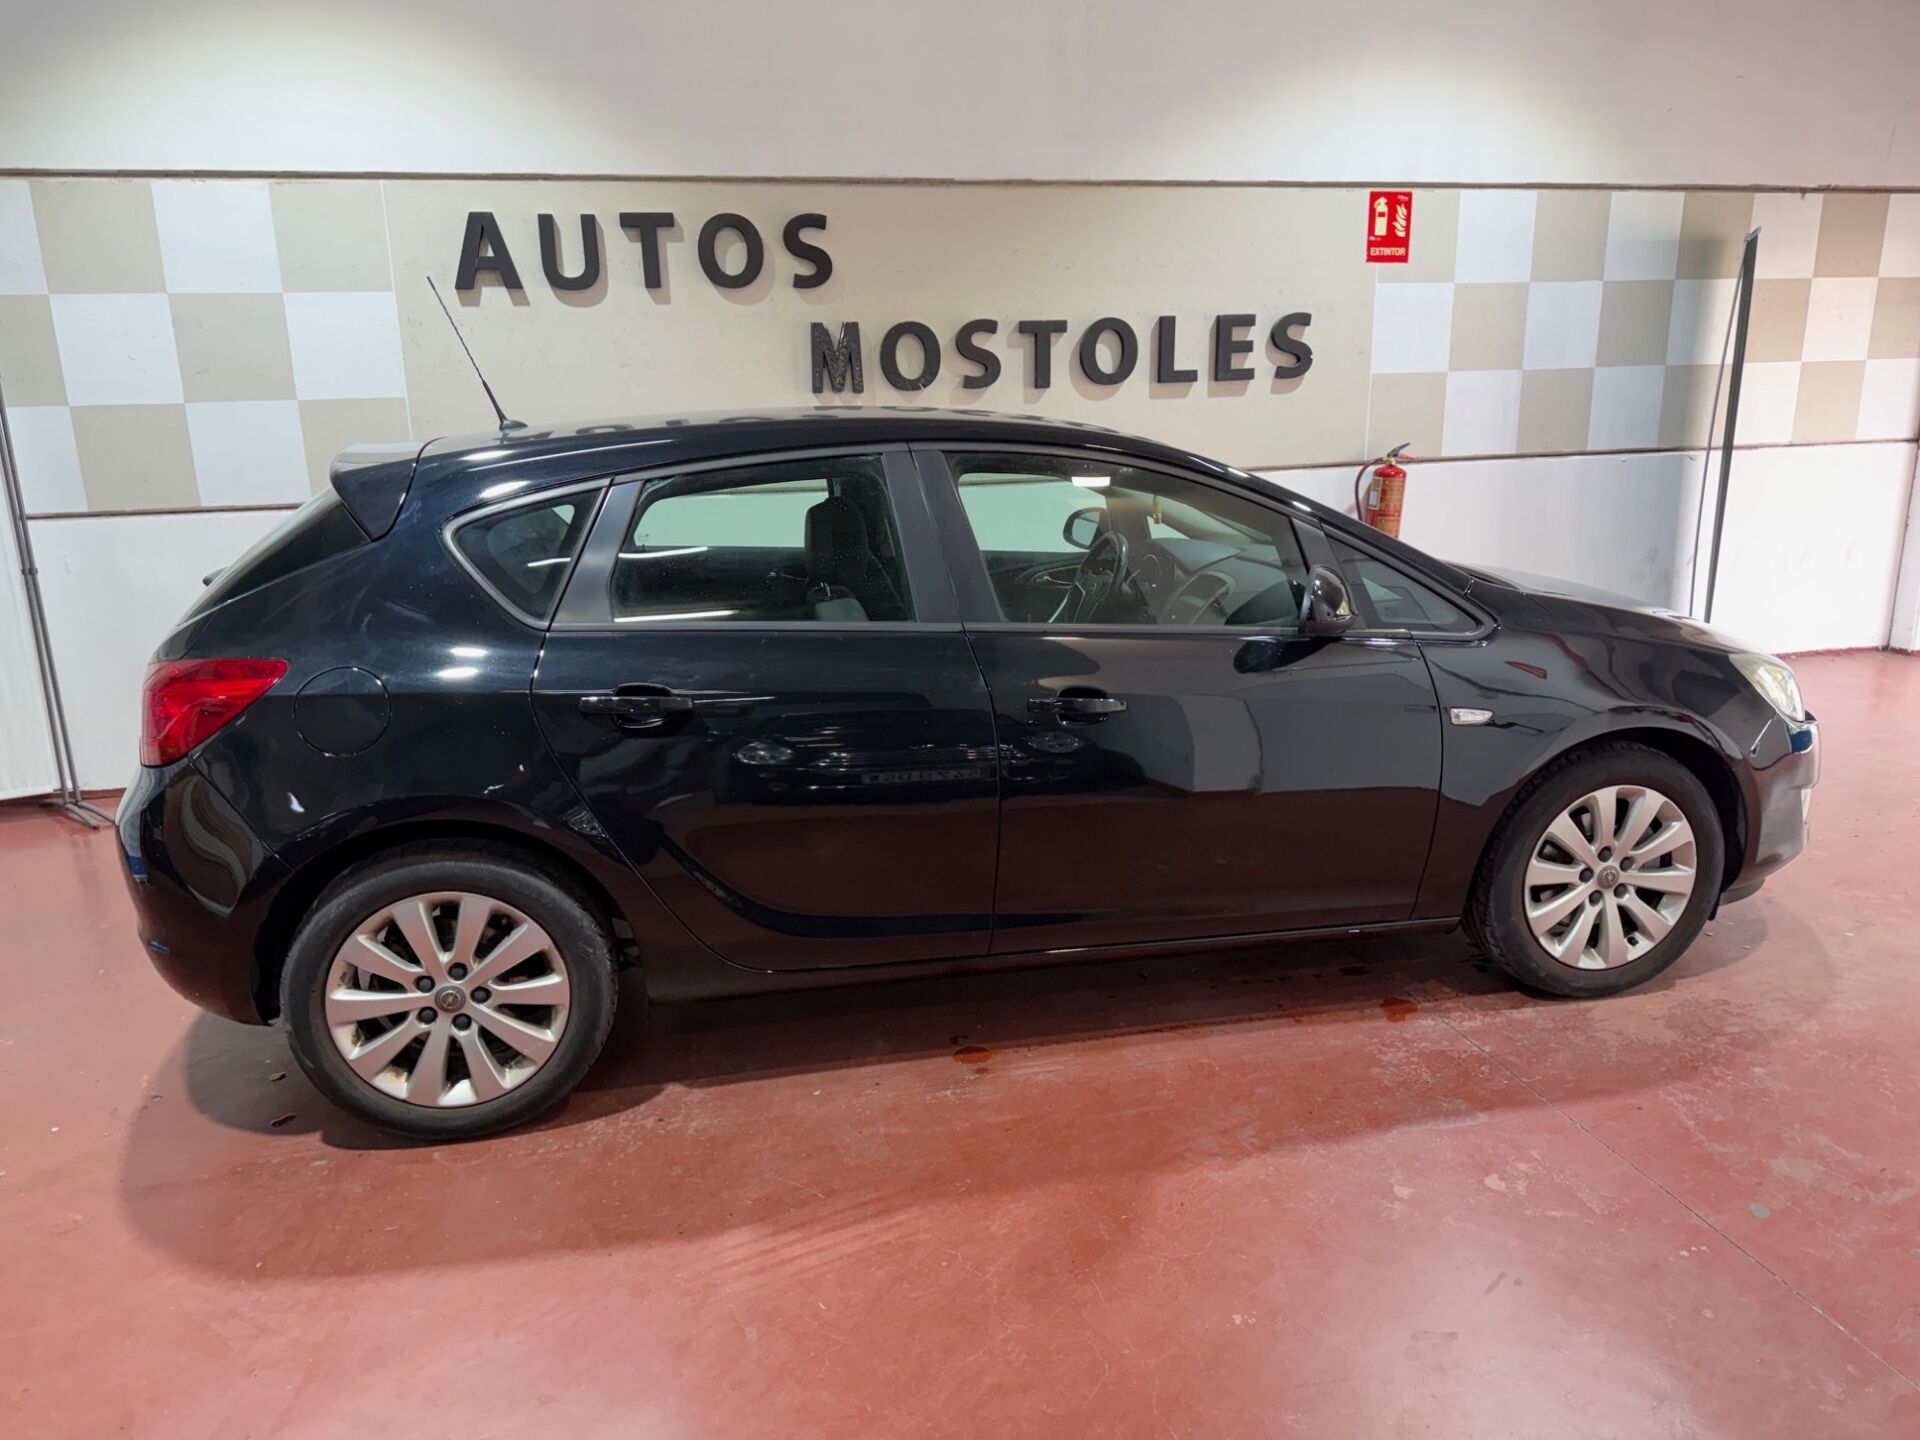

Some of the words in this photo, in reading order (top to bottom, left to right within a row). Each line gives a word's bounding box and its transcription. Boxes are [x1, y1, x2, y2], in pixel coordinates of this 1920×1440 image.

[454, 211, 834, 291] AUTOS
[1370, 247, 1406, 256] EXTINTOR
[810, 312, 1314, 394] MOSTOLES
